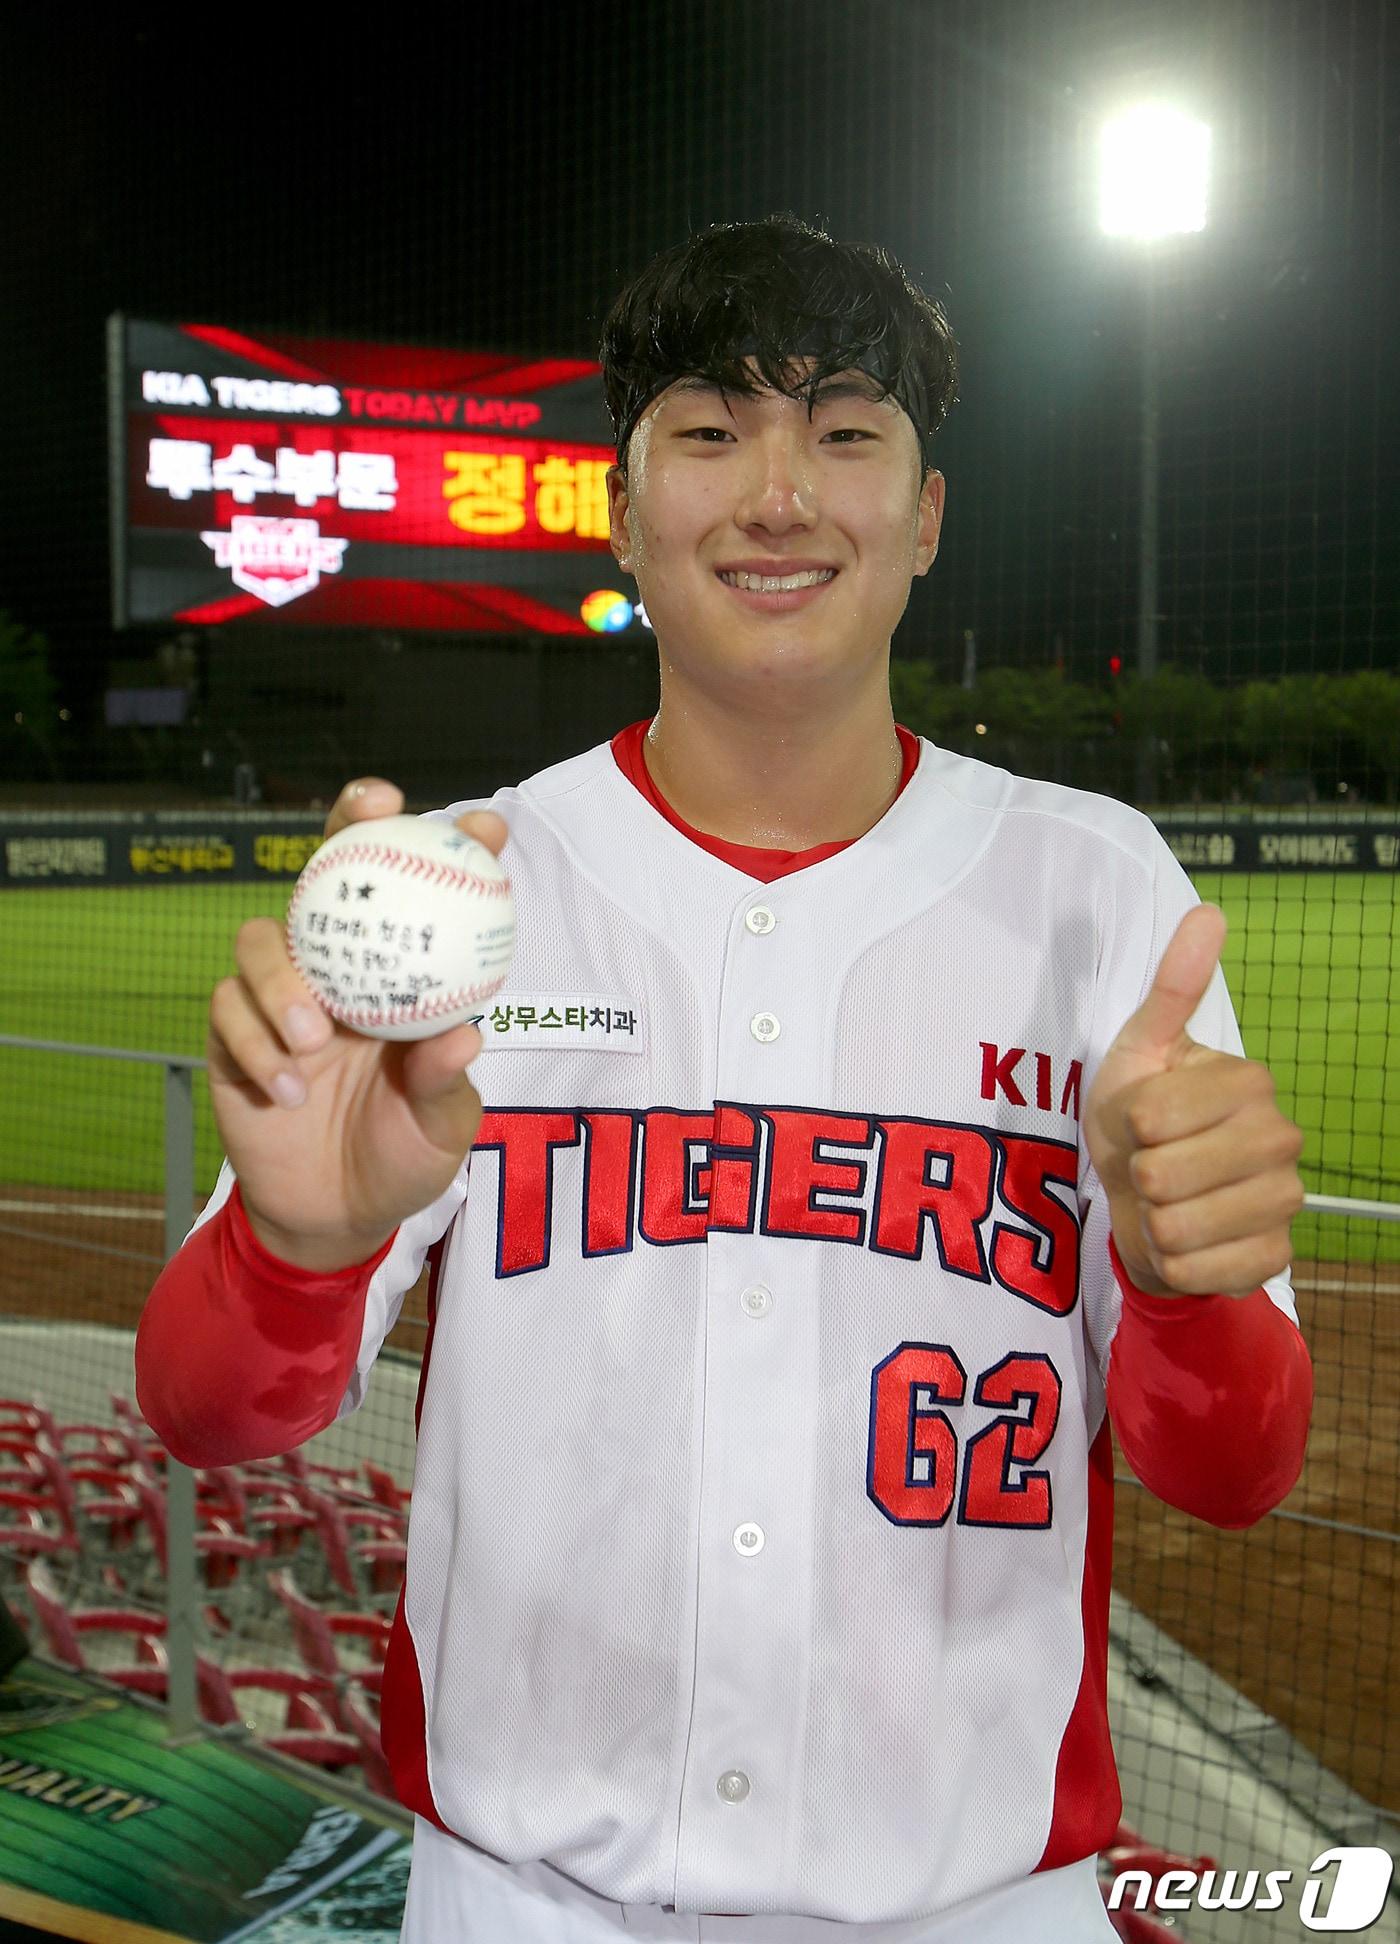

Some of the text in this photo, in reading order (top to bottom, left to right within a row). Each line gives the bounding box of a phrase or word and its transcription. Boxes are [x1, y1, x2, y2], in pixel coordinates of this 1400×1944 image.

[142, 370, 542, 430] KIA TIGERS TODAY MVP
[146, 437, 611, 541] 투수부문 정해
[489, 1005, 637, 1035] 상무스타치과
[470, 1100, 1080, 1318] TIGERS
[866, 1341, 1062, 1528] 62
[0, 1757, 160, 1823] UALITY
